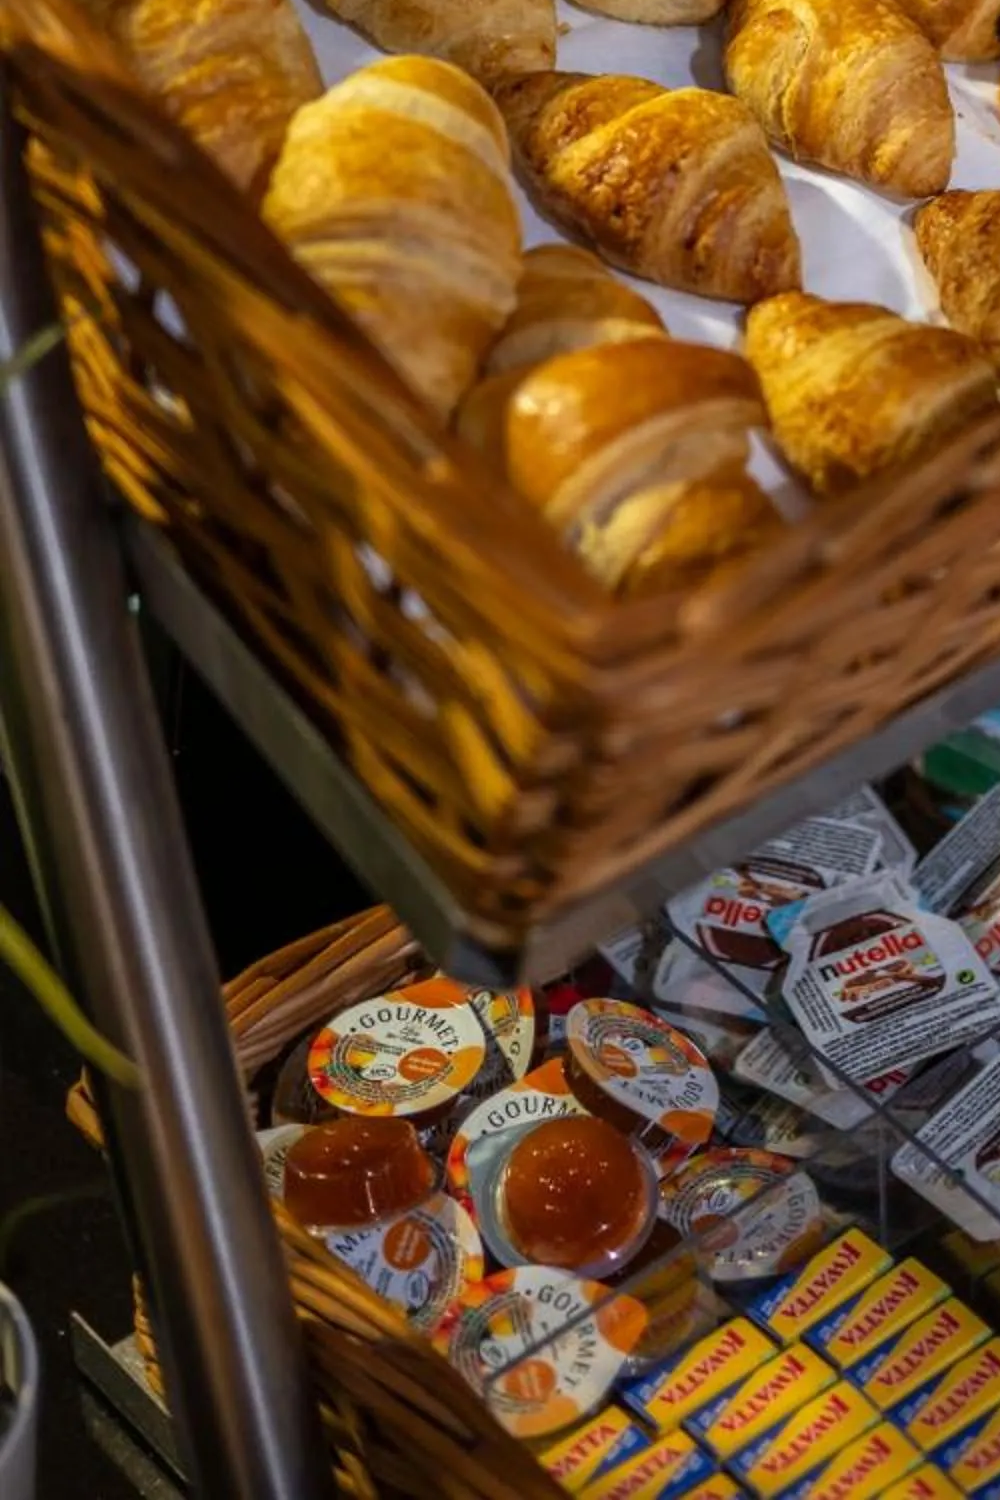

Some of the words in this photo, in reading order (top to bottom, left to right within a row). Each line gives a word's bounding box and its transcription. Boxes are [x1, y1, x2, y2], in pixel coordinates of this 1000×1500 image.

[703, 895, 763, 927] ella
[818, 930, 925, 983] nutella
[358, 1006, 460, 1049] GOURMET
[781, 1240, 862, 1320] KWATTA
[839, 1269, 921, 1347] KWATTA
[537, 1283, 597, 1389] GOURMET
[659, 1327, 746, 1407] KWATTA
[876, 1308, 961, 1388] KWATTA
[719, 1353, 806, 1434] KWATTA
[602, 1447, 681, 1500] WATTA
[761, 1393, 850, 1476] KWATTA
